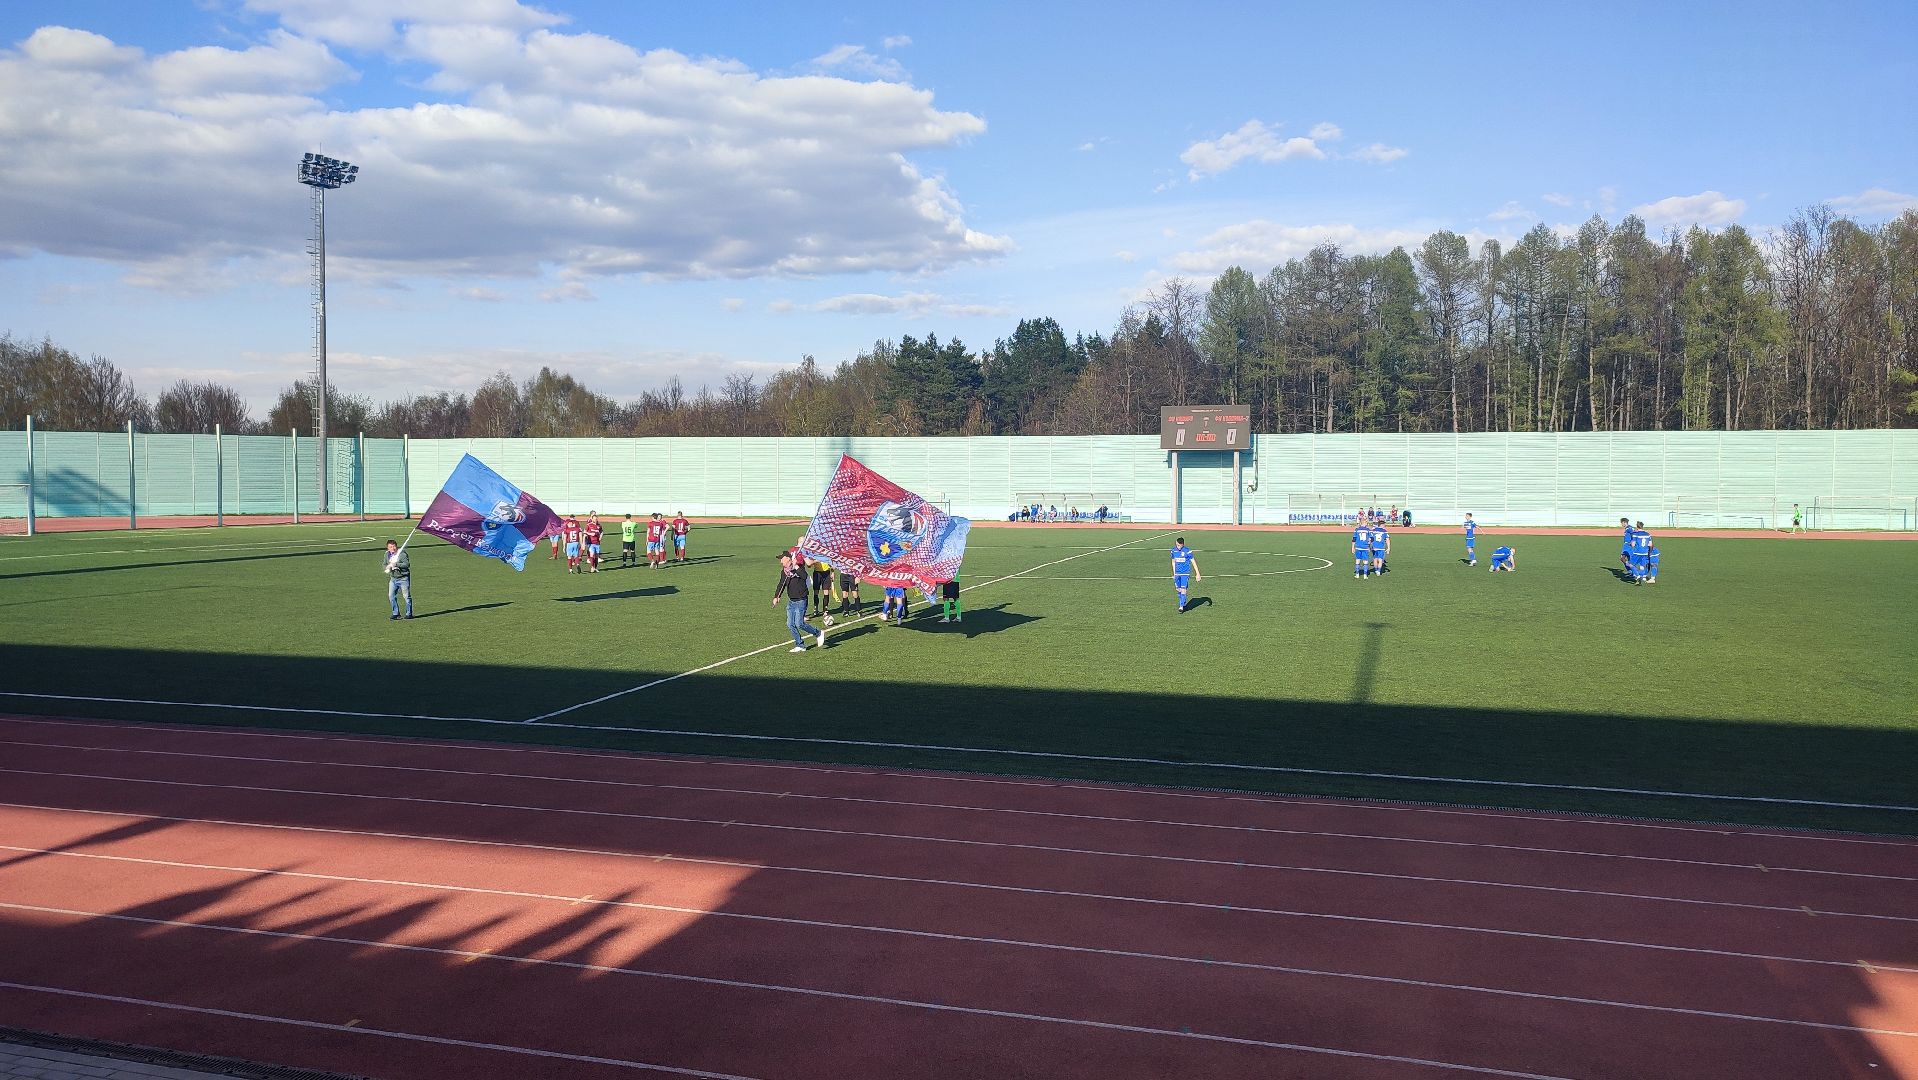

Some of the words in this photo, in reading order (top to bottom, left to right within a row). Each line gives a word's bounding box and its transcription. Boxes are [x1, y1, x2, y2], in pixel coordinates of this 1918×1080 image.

[1176, 429, 1185, 445] 0
[1227, 429, 1236, 445] 0
[569, 531, 577, 540] 15
[803, 539, 867, 574] Вперед
